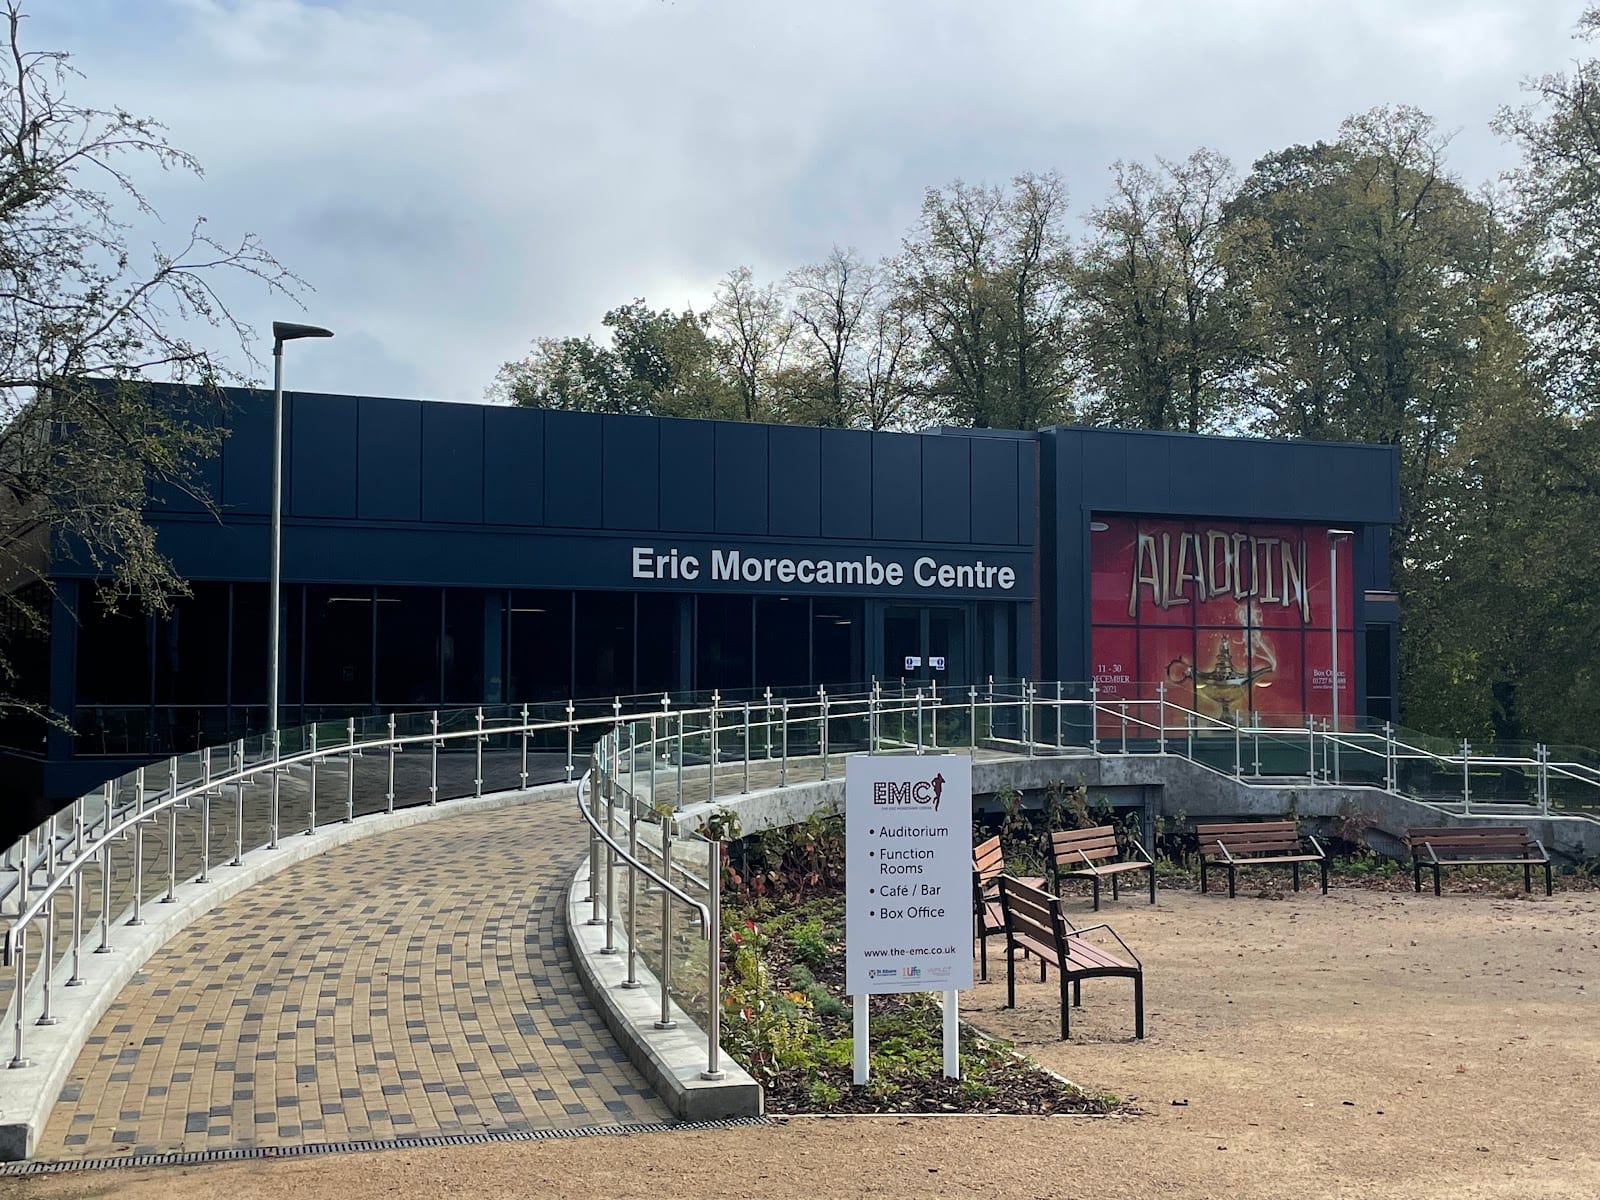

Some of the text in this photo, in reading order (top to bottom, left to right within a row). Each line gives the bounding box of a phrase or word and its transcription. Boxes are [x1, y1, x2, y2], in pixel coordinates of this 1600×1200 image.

[632, 547, 1016, 589] Eric Morecambe Centre
[1128, 529, 1311, 623] ALADDIN
[1097, 664, 1106, 673] 11
[1112, 664, 1122, 673] 30
[874, 781, 932, 805] EMC
[879, 826, 949, 838] Auditorium
[880, 848, 934, 860] Function
[880, 863, 923, 875] Rooms
[880, 885, 908, 897] Café
[921, 884, 941, 896] Bar
[880, 906, 945, 919] Box Office
[864, 946, 956, 957] www.the-emc.co.uk
